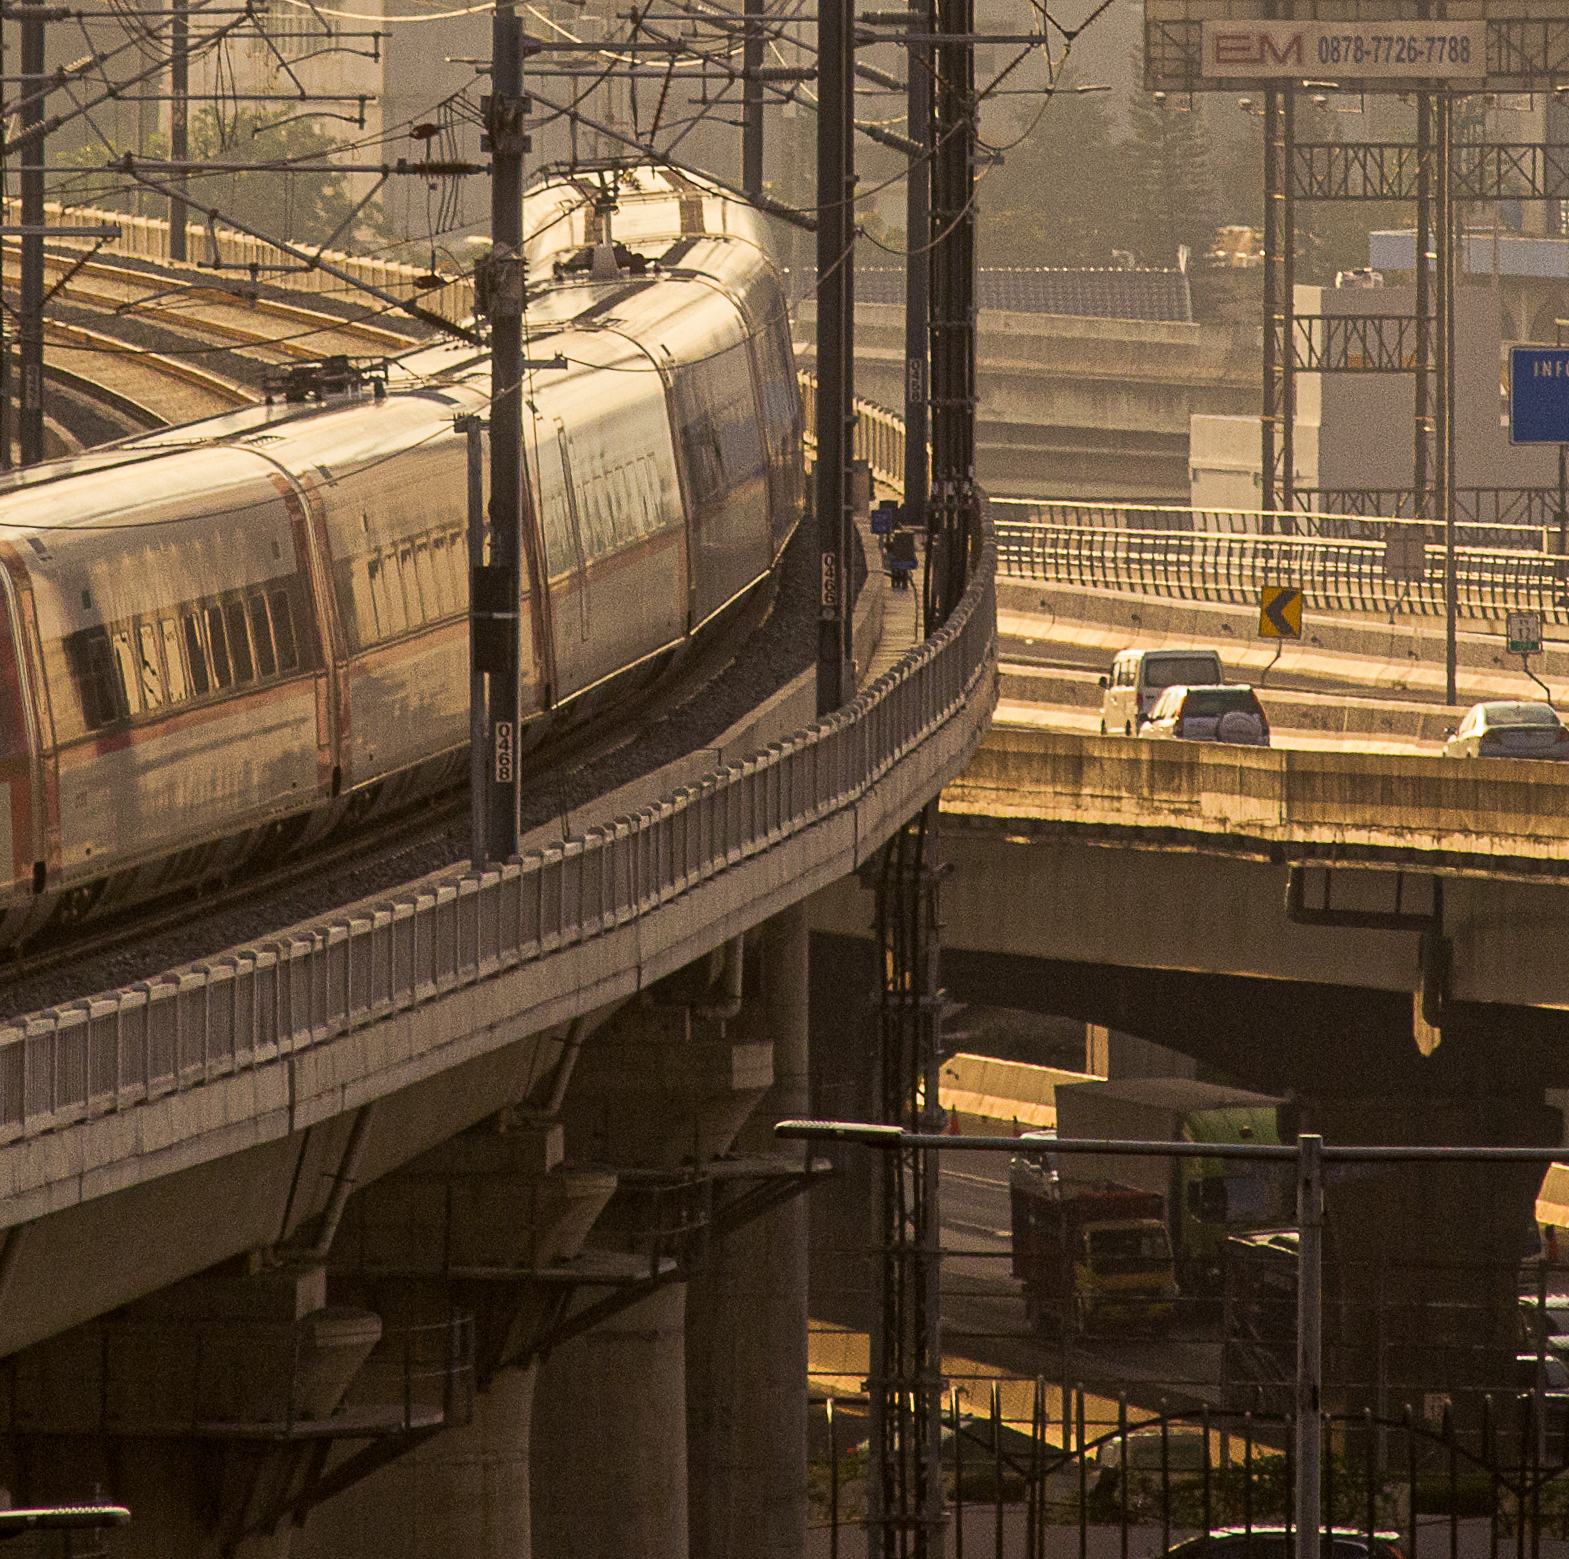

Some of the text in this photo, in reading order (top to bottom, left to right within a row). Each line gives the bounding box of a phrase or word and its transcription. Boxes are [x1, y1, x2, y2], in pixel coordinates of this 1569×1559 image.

[1215, 34, 1470, 64] EM 0878-7726-7788
[499, 724, 510, 780] 0468
